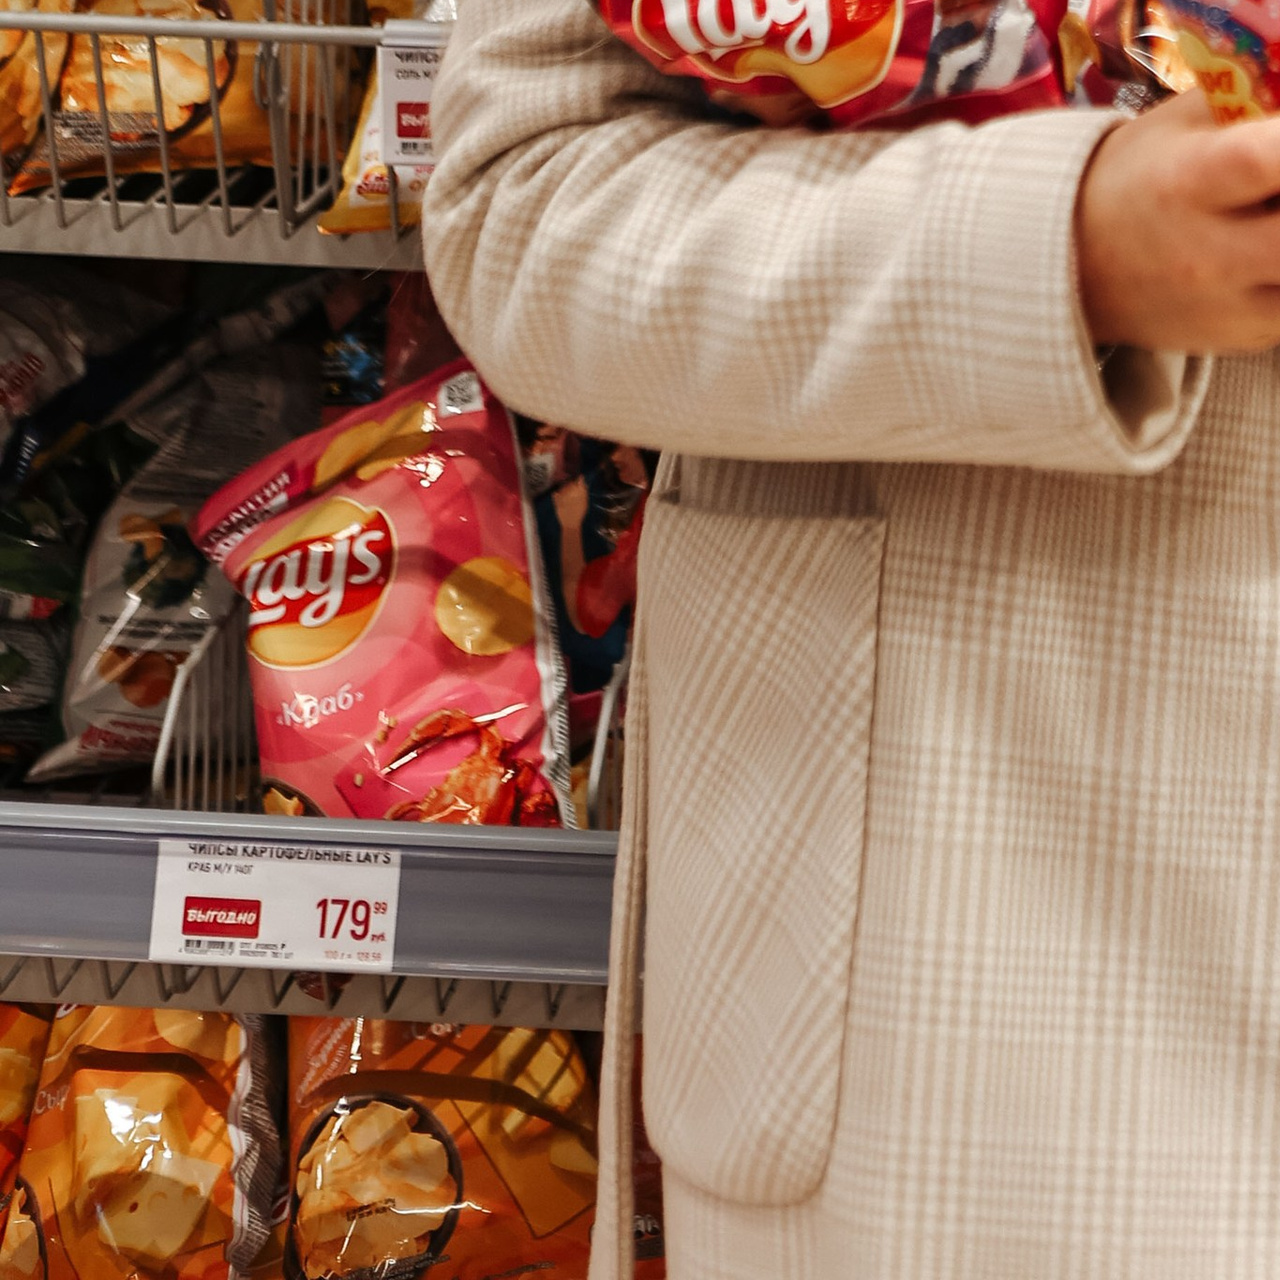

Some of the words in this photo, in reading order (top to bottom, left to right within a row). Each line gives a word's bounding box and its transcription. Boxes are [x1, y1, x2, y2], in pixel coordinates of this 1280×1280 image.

[394, 50, 440, 64] ЧИПС
[243, 522, 385, 629] Lay's
[188, 842, 238, 857] ЧИПСЫ
[241, 845, 353, 863] КАРТОФЕЛЬНЫЕ
[357, 850, 391, 865] LAY'S
[187, 861, 212, 873] КРАБ
[213, 863, 232, 874] М/У
[186, 907, 257, 926] ВЫГОДНО
[373, 901, 388, 915] 99
[316, 897, 371, 941] 179
